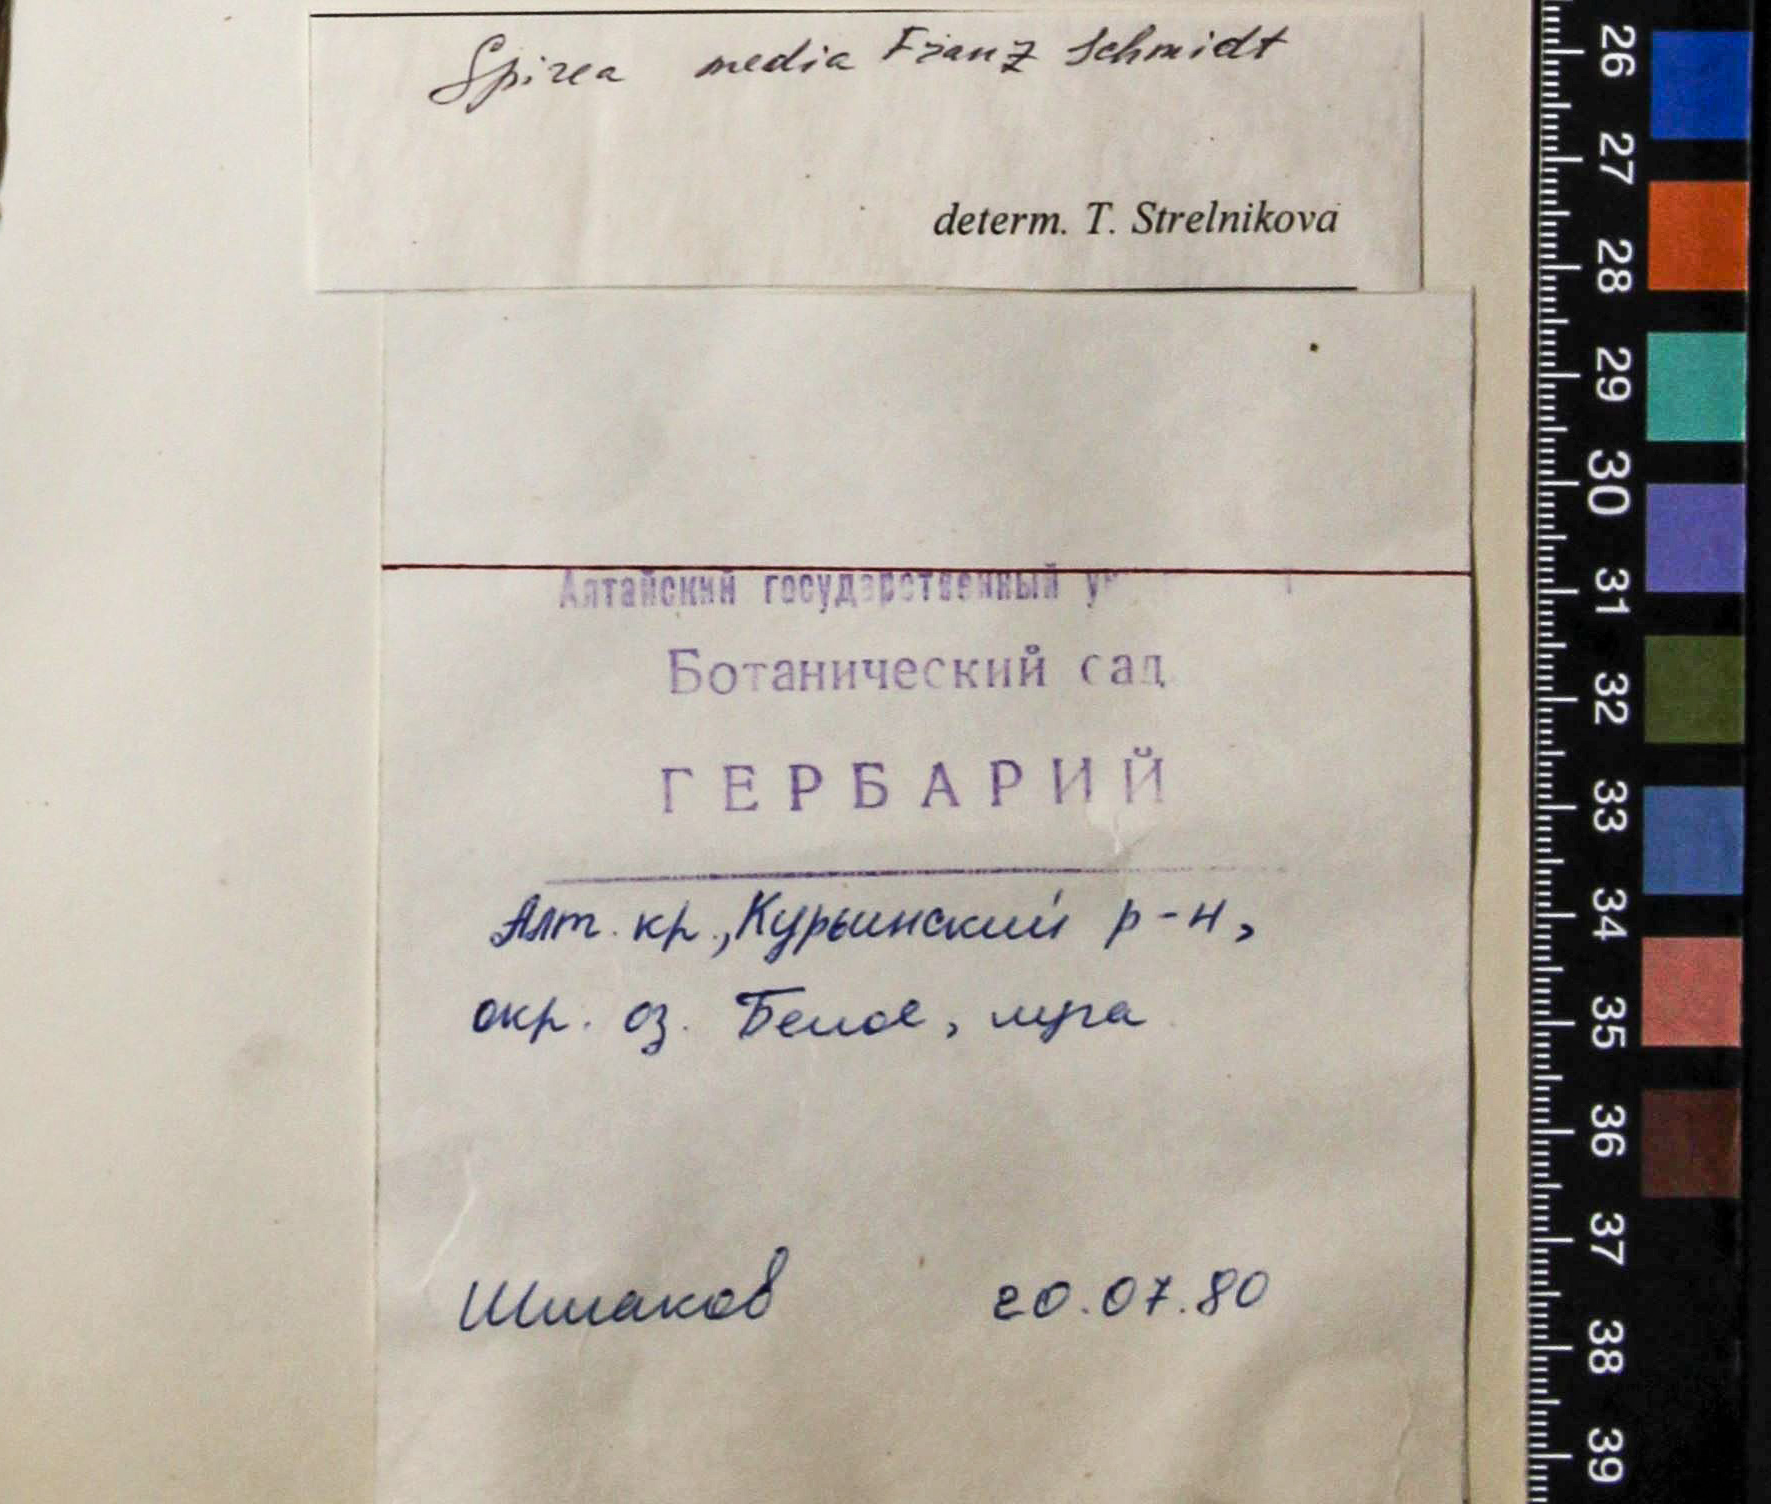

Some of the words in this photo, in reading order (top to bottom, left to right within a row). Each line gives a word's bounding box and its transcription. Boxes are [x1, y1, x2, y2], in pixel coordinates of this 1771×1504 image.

[694, 38, 856, 78] media
[1600, 24, 1636, 78] 26
[1599, 132, 1635, 185] 27
[933, 201, 1068, 236] determ.
[1086, 201, 1116, 235] T.
[1131, 200, 1340, 235] Strelnikova
[1597, 238, 1633, 294] 28
[1596, 347, 1632, 402] 29
[1587, 449, 1631, 516] 30
[1595, 567, 1630, 613] 31
[667, 644, 1046, 695] Ботанический
[1080, 652, 1167, 689] сад
[1594, 672, 1629, 725] 32
[661, 747, 1165, 814] ГЕРБАРИЙ
[1593, 780, 1628, 832] 33
[1592, 888, 1627, 941] 34
[1591, 996, 1627, 1049] 35
[1590, 1104, 1626, 1158] 36
[1590, 1212, 1625, 1265] 37
[993, 1268, 1270, 1320] 20.07.80
[1588, 1319, 1624, 1374] 38
[1587, 1427, 1624, 1483] 39
